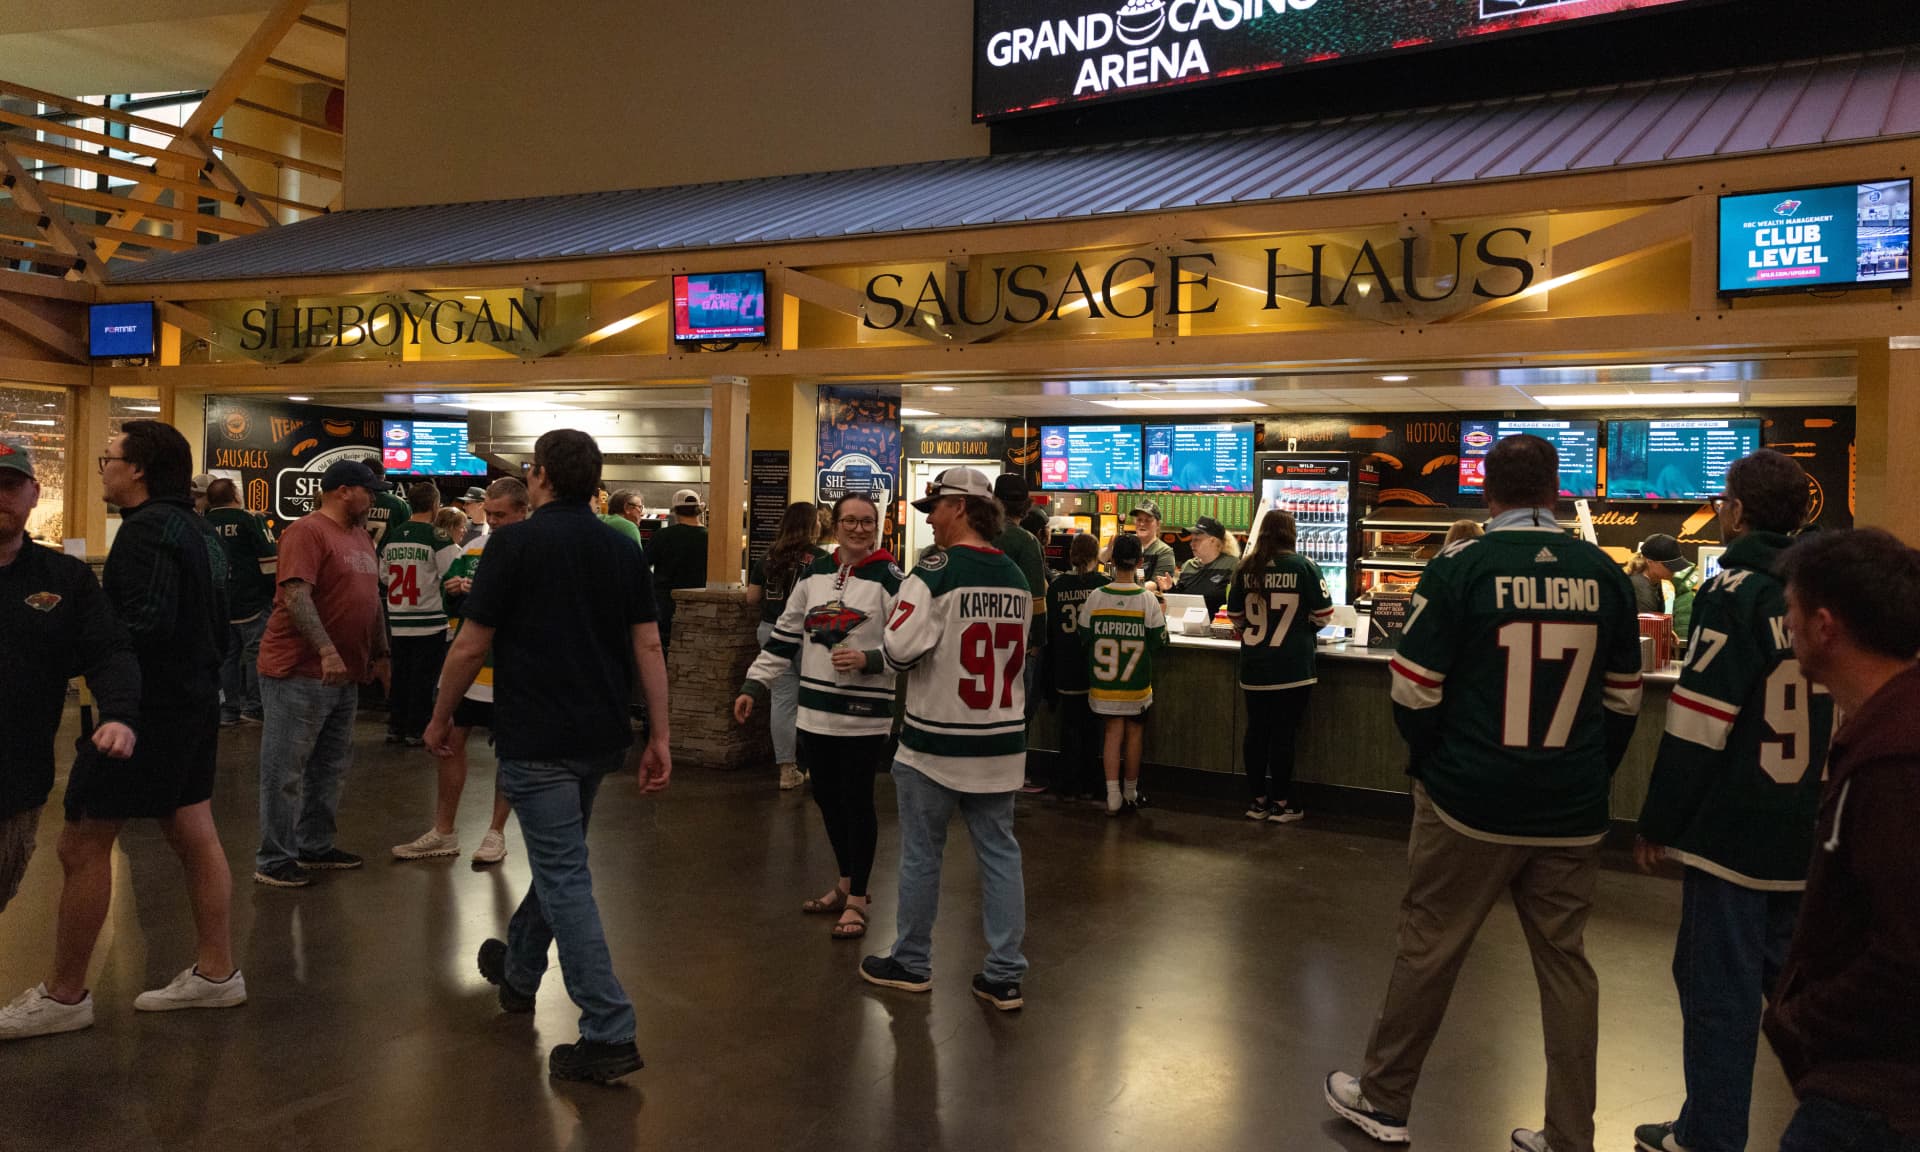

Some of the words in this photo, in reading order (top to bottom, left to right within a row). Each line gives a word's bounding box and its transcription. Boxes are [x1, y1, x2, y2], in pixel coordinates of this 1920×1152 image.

[987, 12, 1113, 67] GRAND
[1072, 39, 1210, 96] ARENA
[1755, 224, 1821, 247] CLUB
[1757, 219, 1785, 227] WEALTH
[1785, 215, 1834, 225] MANAGEMENT
[1748, 245, 1829, 268] LEVEL
[863, 252, 1219, 329] SAUSAGE
[1263, 227, 1534, 310] HAUS
[702, 300, 738, 311] GAME
[105, 325, 137, 333] FORTINET
[240, 296, 545, 352] SHEBOYGAN
[215, 448, 269, 469] SAUSAGES
[921, 441, 934, 455] OLD
[936, 441, 960, 455] WORLD
[962, 441, 988, 455] FLAVOR
[388, 564, 420, 606] 24
[1495, 576, 1600, 612] FOLIGNO
[960, 591, 1027, 619] KAPRIZOV
[1243, 592, 1300, 647] 97
[1094, 621, 1145, 637] KAPRIZOV
[957, 622, 1024, 710] 97
[1092, 638, 1145, 682] 97
[1498, 621, 1599, 748] 17
